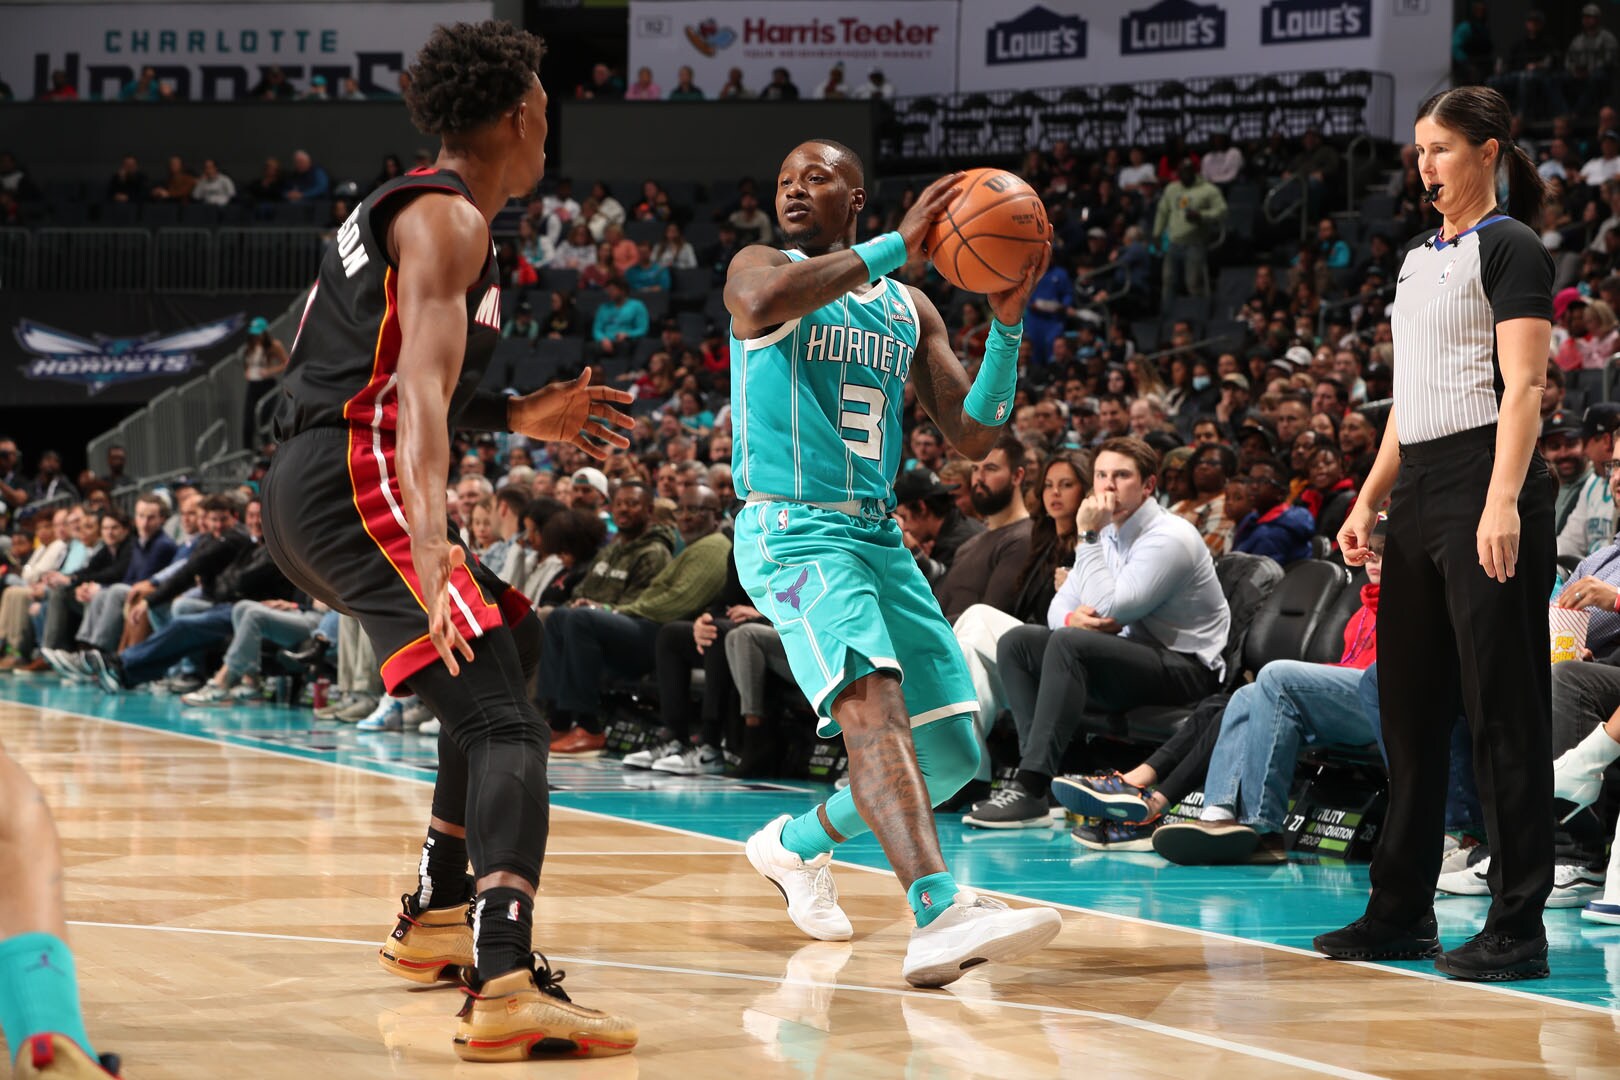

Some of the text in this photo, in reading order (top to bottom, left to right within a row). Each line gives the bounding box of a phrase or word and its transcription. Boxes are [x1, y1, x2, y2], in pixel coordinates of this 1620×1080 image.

[743, 18, 939, 44] Harris Teeter
[1130, 14, 1217, 48] LOWE'S
[1271, 3, 1362, 38] LOWE'S
[104, 30, 338, 53] CHARLOTTE
[995, 25, 1078, 59] LOWE'S
[474, 285, 500, 331] MI
[33, 355, 187, 375] HORNETS
[805, 323, 915, 384] HORNETS
[840, 383, 888, 461] 3
[1288, 815, 1305, 832] 27
[1314, 823, 1356, 840] INNOVATION
